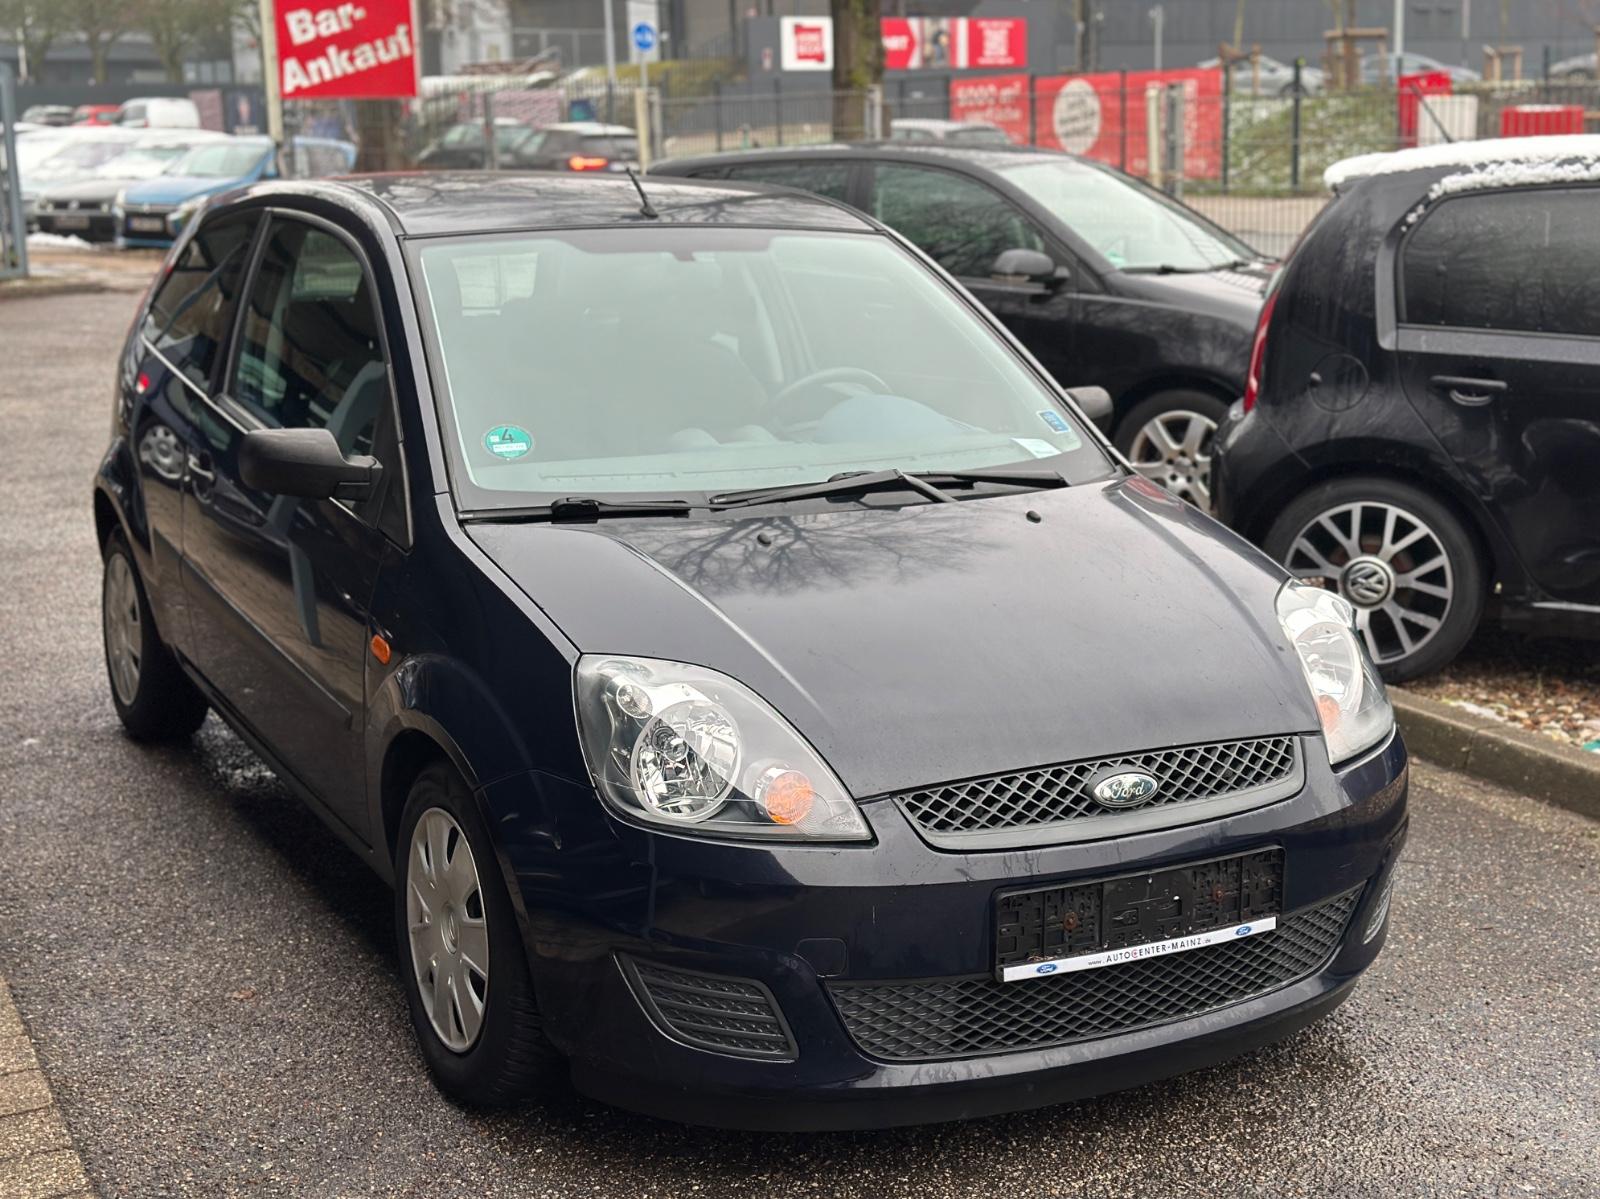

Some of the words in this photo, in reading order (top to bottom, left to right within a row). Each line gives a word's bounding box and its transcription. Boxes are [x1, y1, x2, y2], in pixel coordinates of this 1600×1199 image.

[284, 3, 366, 46] Bar-
[283, 24, 412, 93] Ankauf
[501, 428, 514, 444] 4
